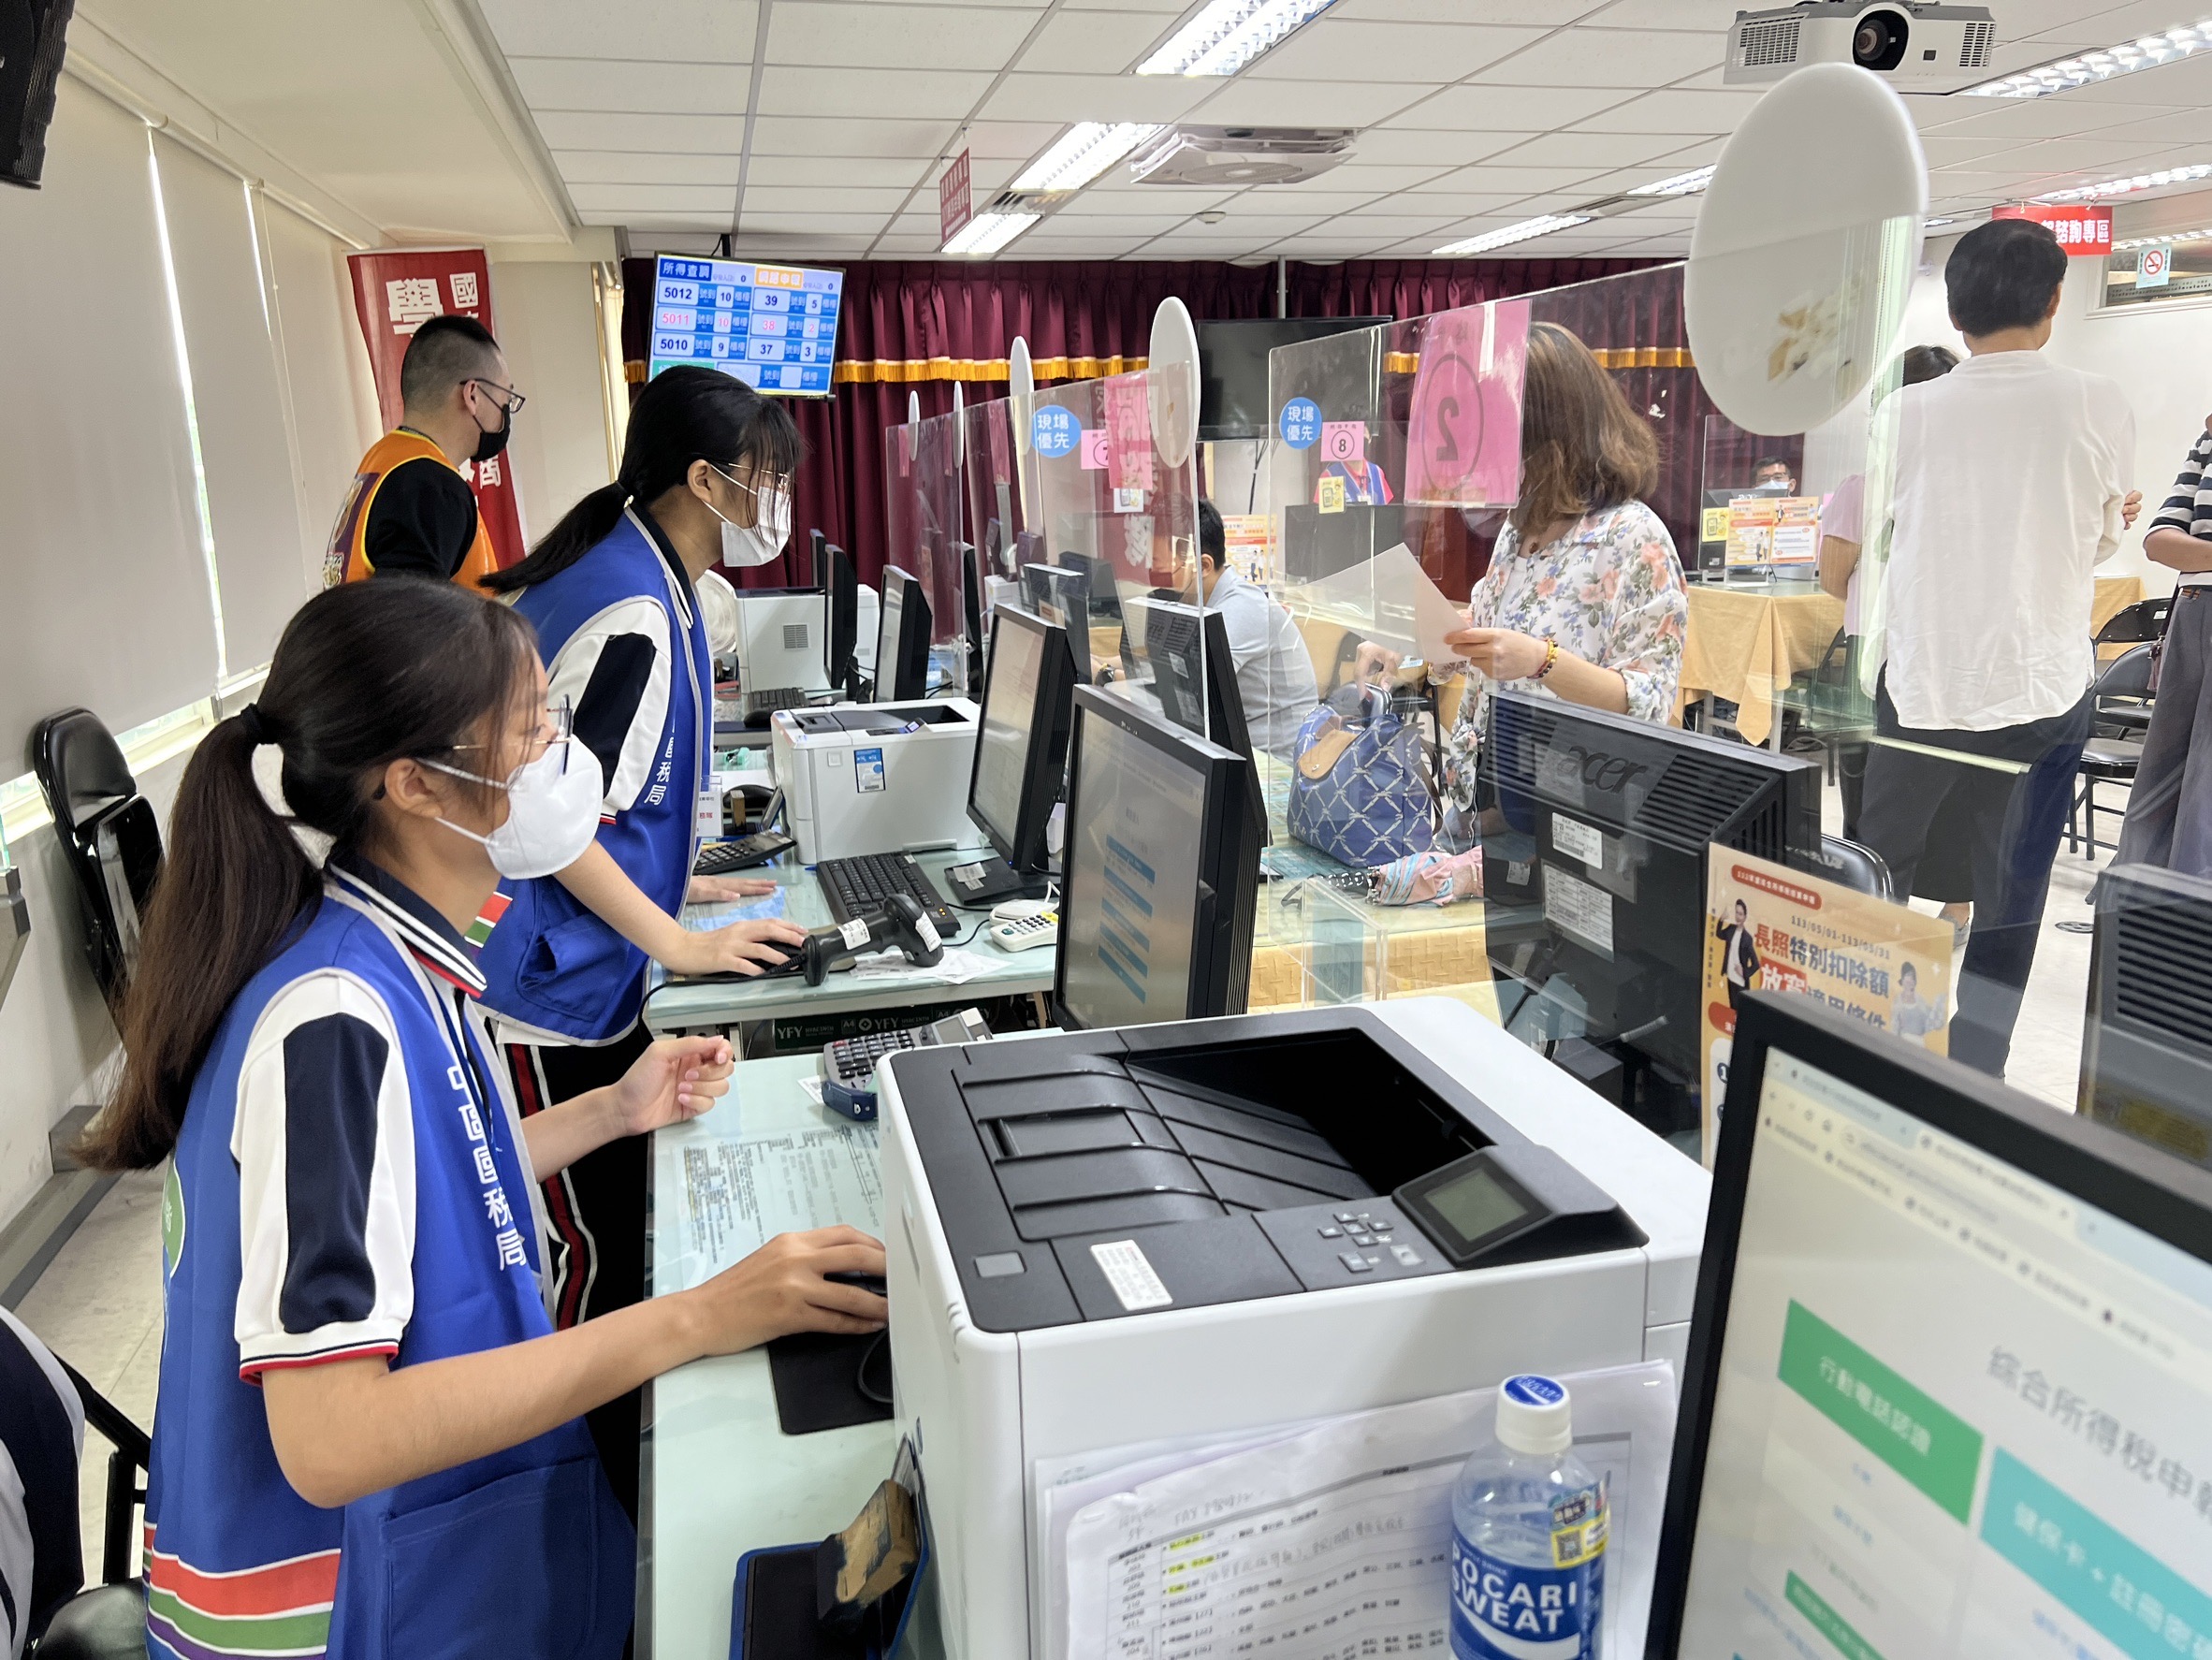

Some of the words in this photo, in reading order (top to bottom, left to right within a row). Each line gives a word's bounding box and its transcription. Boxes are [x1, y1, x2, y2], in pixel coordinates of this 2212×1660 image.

[740, 275, 747, 284] 0
[664, 287, 692, 299] 5012
[720, 292, 732, 301] 10
[764, 296, 778, 306] 39
[662, 313, 690, 325] 5011
[718, 317, 729, 327] 10
[763, 320, 775, 330] 38
[809, 324, 815, 332] 2
[660, 339, 688, 350] 5010
[718, 342, 724, 352] 9
[760, 344, 773, 354] 37
[805, 347, 811, 357] 3
[1288, 406, 1314, 422] 現場
[1038, 415, 1069, 430] 現場
[1288, 425, 1314, 441] 優先
[1038, 433, 1070, 449] 優先
[1338, 439, 1346, 452] 8
[1557, 746, 1648, 794] acer
[1754, 923, 1889, 998] 長照特別扣除額
[843, 1019, 854, 1027] A4
[874, 1017, 899, 1030] YFY
[777, 1026, 803, 1040] YFY
[1452, 1540, 1578, 1609] POCARI
[1452, 1565, 1564, 1634] SWEAT
